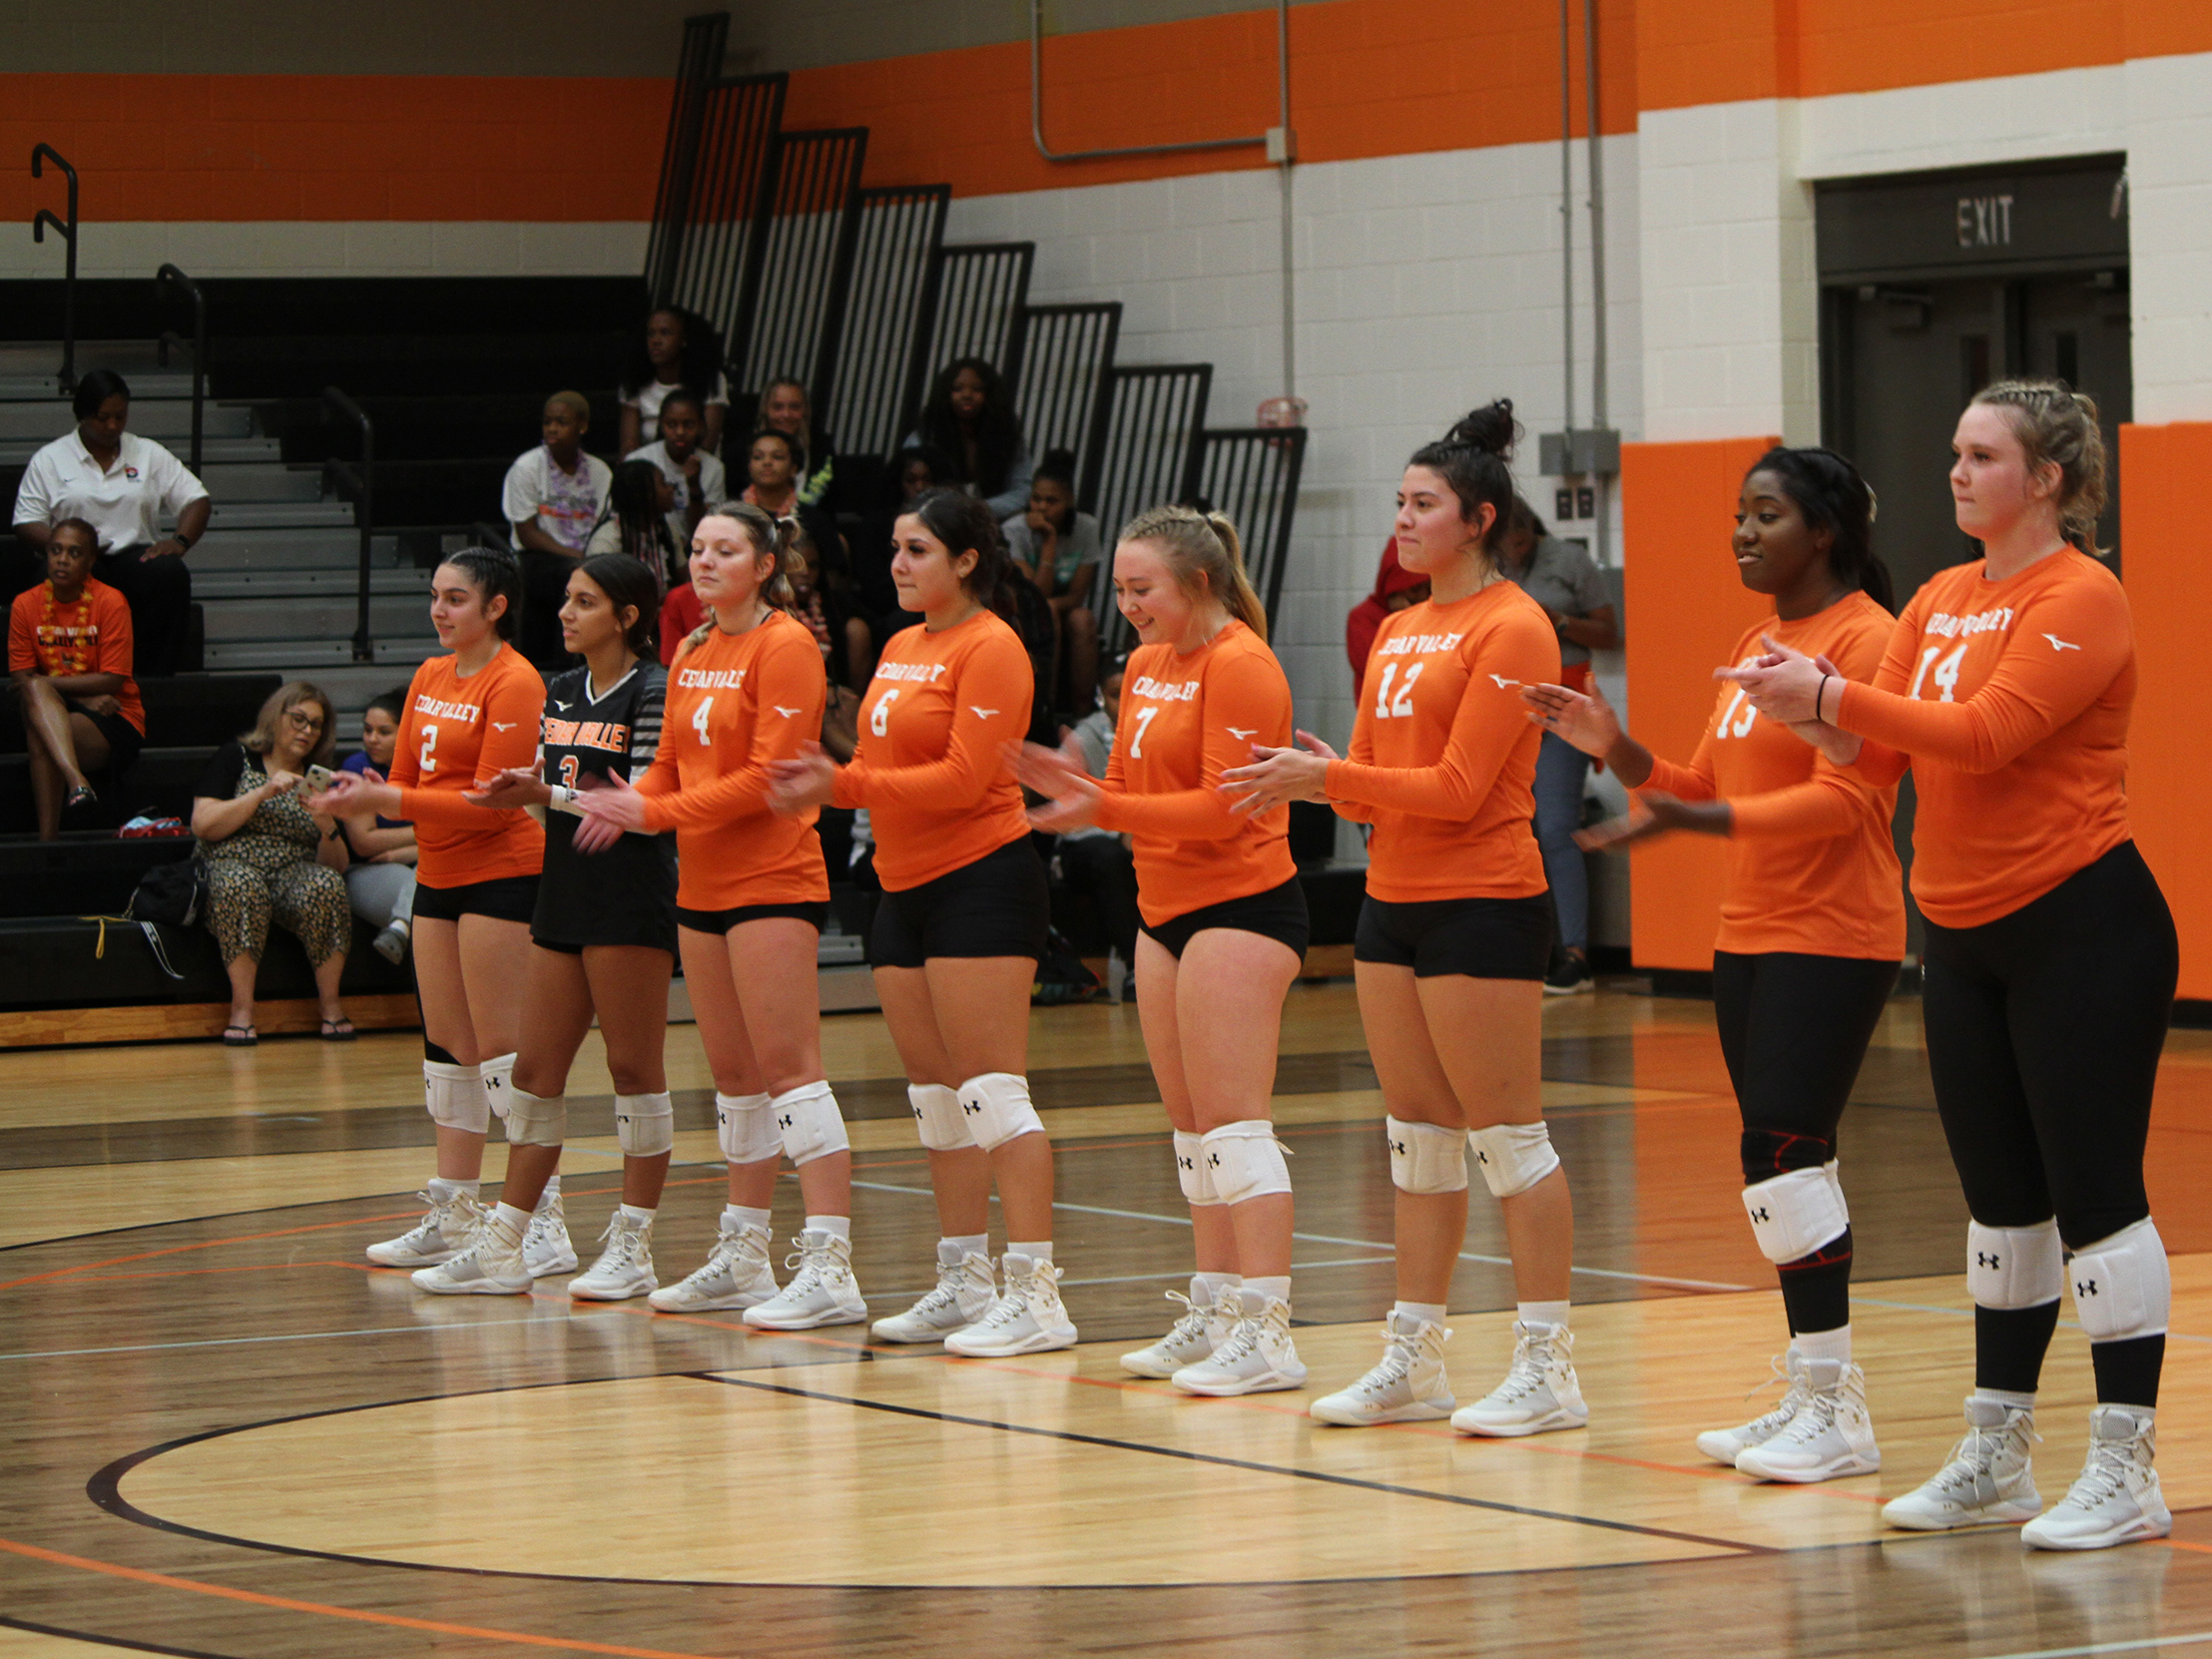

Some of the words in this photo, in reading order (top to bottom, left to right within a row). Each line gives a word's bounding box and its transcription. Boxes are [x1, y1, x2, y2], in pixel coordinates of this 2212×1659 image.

[1957, 195, 2014, 248] EXIT
[1376, 662, 1424, 719] 12
[1910, 643, 1968, 703] 14
[692, 696, 715, 747] 4
[870, 688, 900, 738] 6
[1129, 706, 1159, 760] 7
[419, 724, 439, 773] 2
[558, 754, 580, 790] 3
